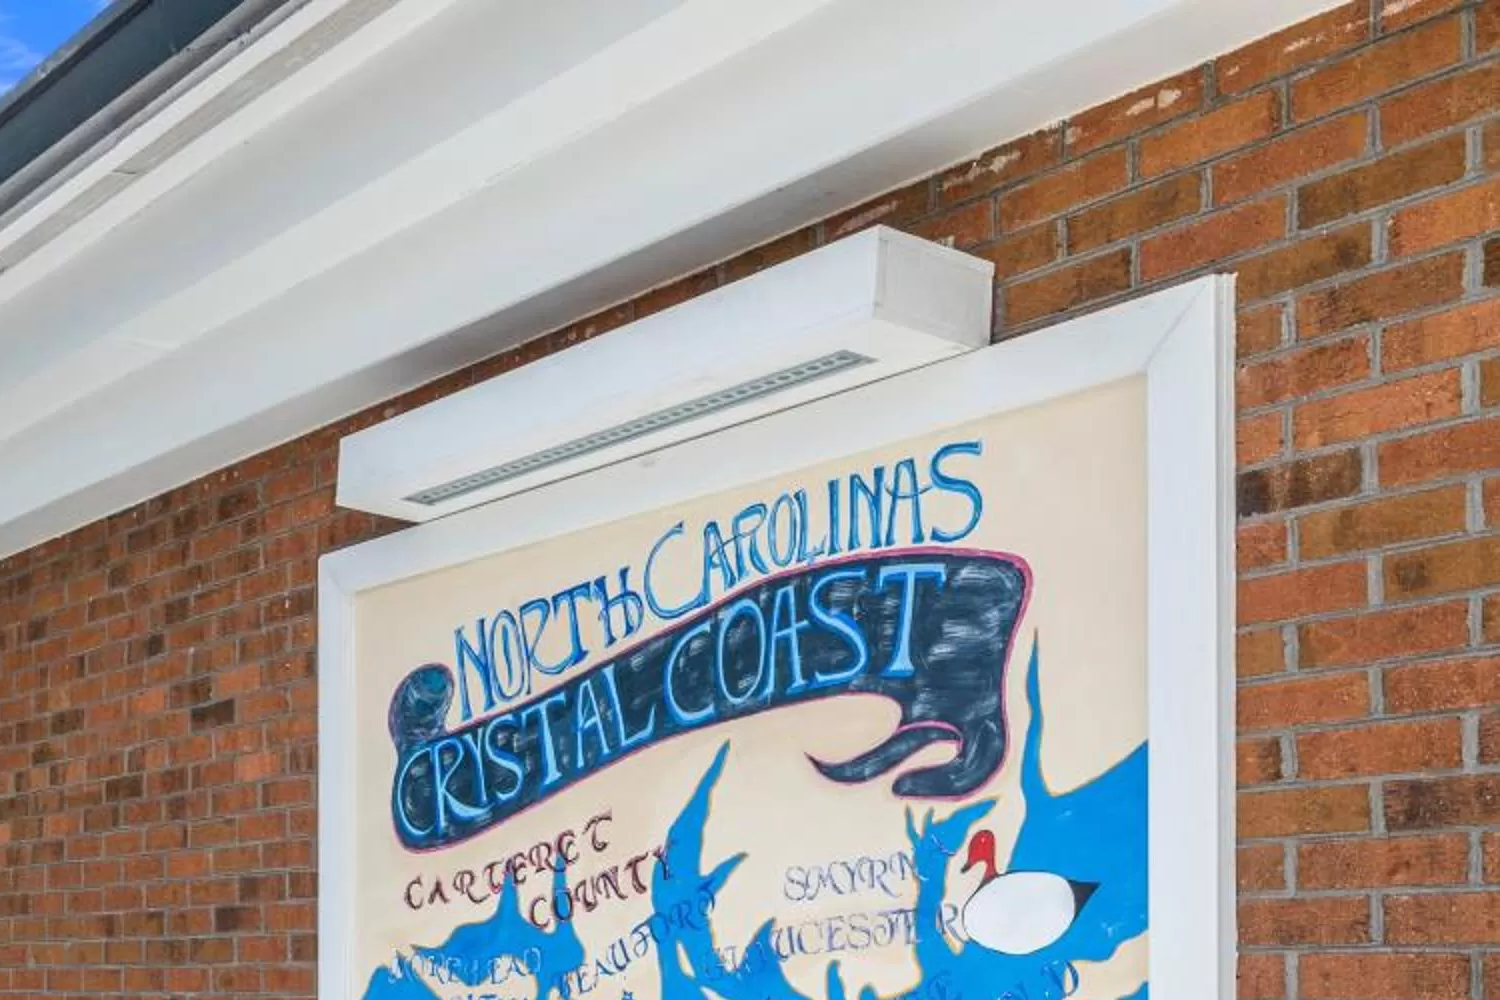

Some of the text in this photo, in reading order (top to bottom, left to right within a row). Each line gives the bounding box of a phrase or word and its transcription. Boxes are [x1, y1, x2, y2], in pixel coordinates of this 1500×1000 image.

[453, 438, 984, 721] NORTH CAROLINAS
[395, 562, 948, 835] CRYSTAL COAST
[404, 808, 613, 910] CARTERET
[529, 844, 674, 929] COUNTY
